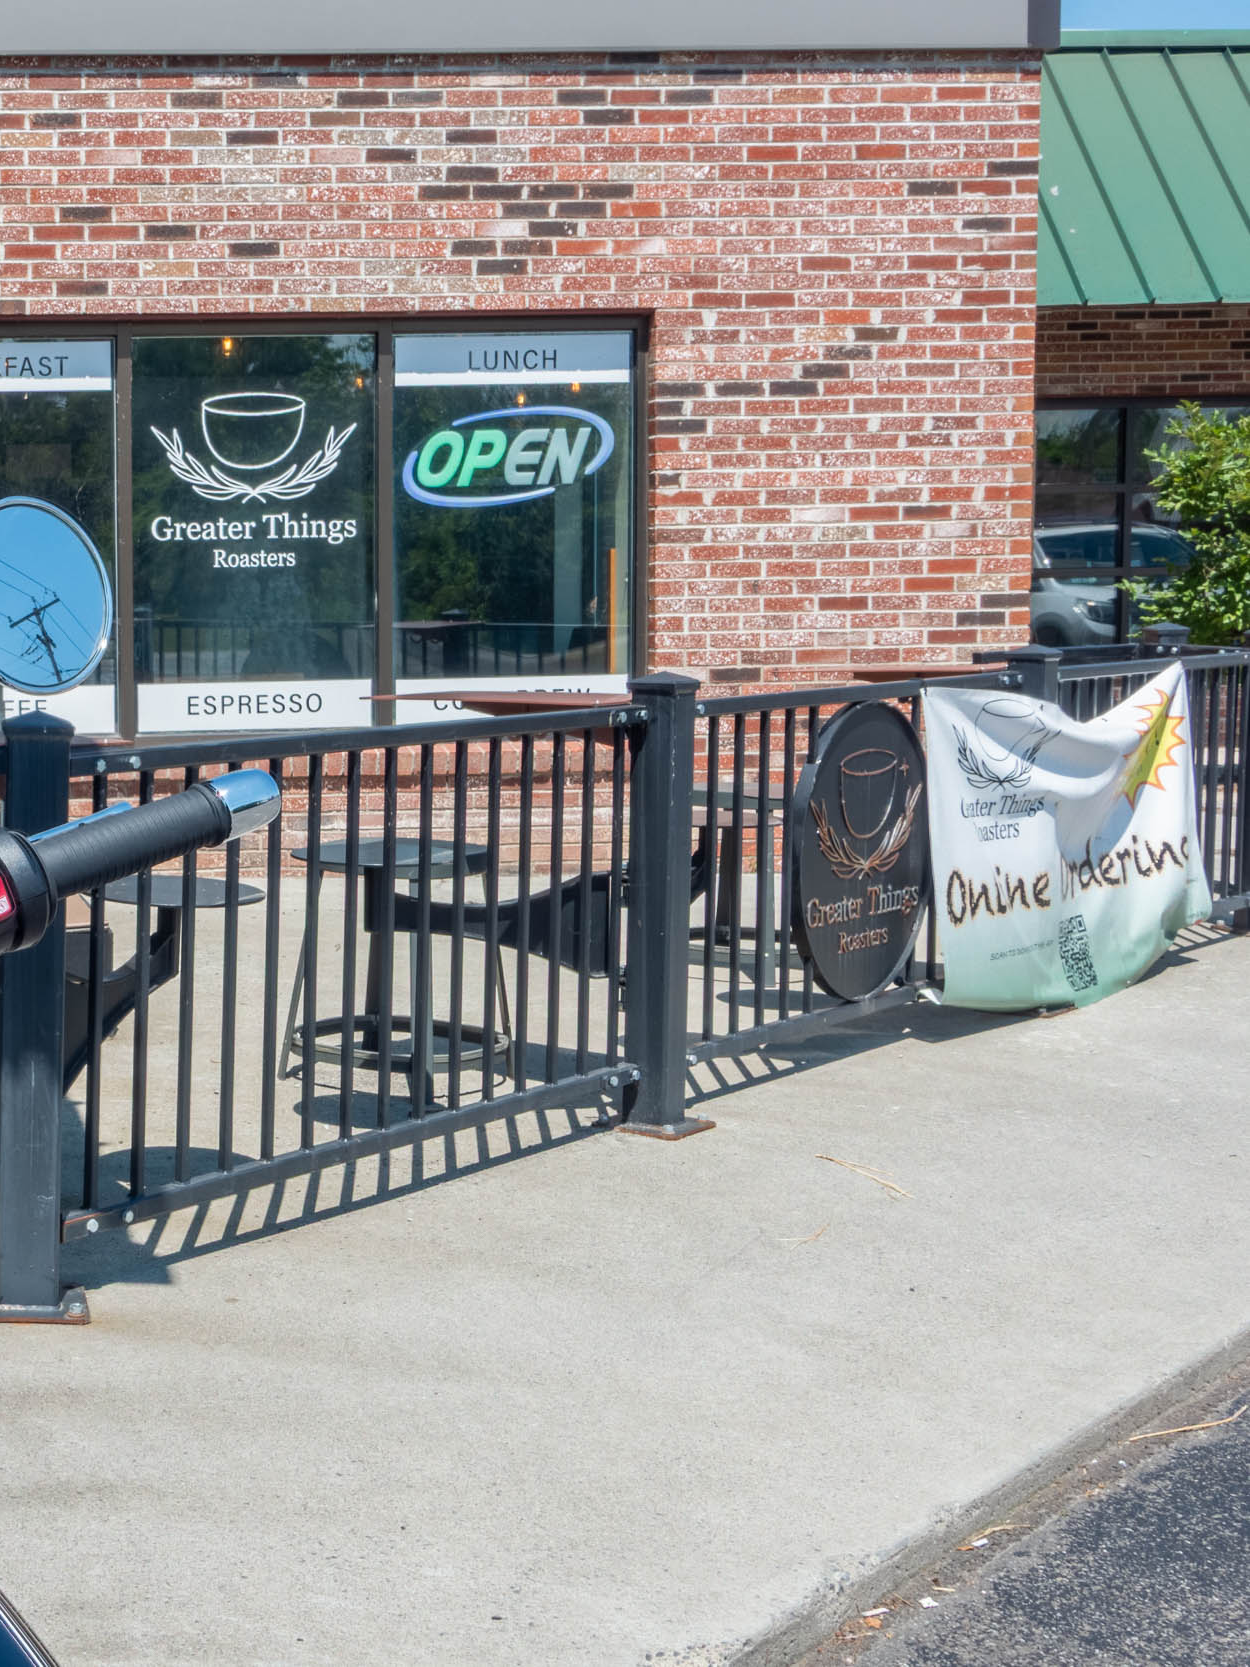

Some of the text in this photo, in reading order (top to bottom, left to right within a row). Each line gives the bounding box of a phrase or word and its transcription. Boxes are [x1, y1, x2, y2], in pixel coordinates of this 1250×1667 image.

[468, 349, 558, 371] LUNCH
[417, 427, 592, 488] OPEN
[151, 512, 357, 544] Greater Things
[213, 549, 296, 568] Roasters
[187, 693, 323, 715] ESPRESSO
[998, 793, 1045, 817] Things
[973, 820, 1020, 842] oasters
[807, 884, 919, 928] Greater Things
[838, 928, 888, 954] Roasters
